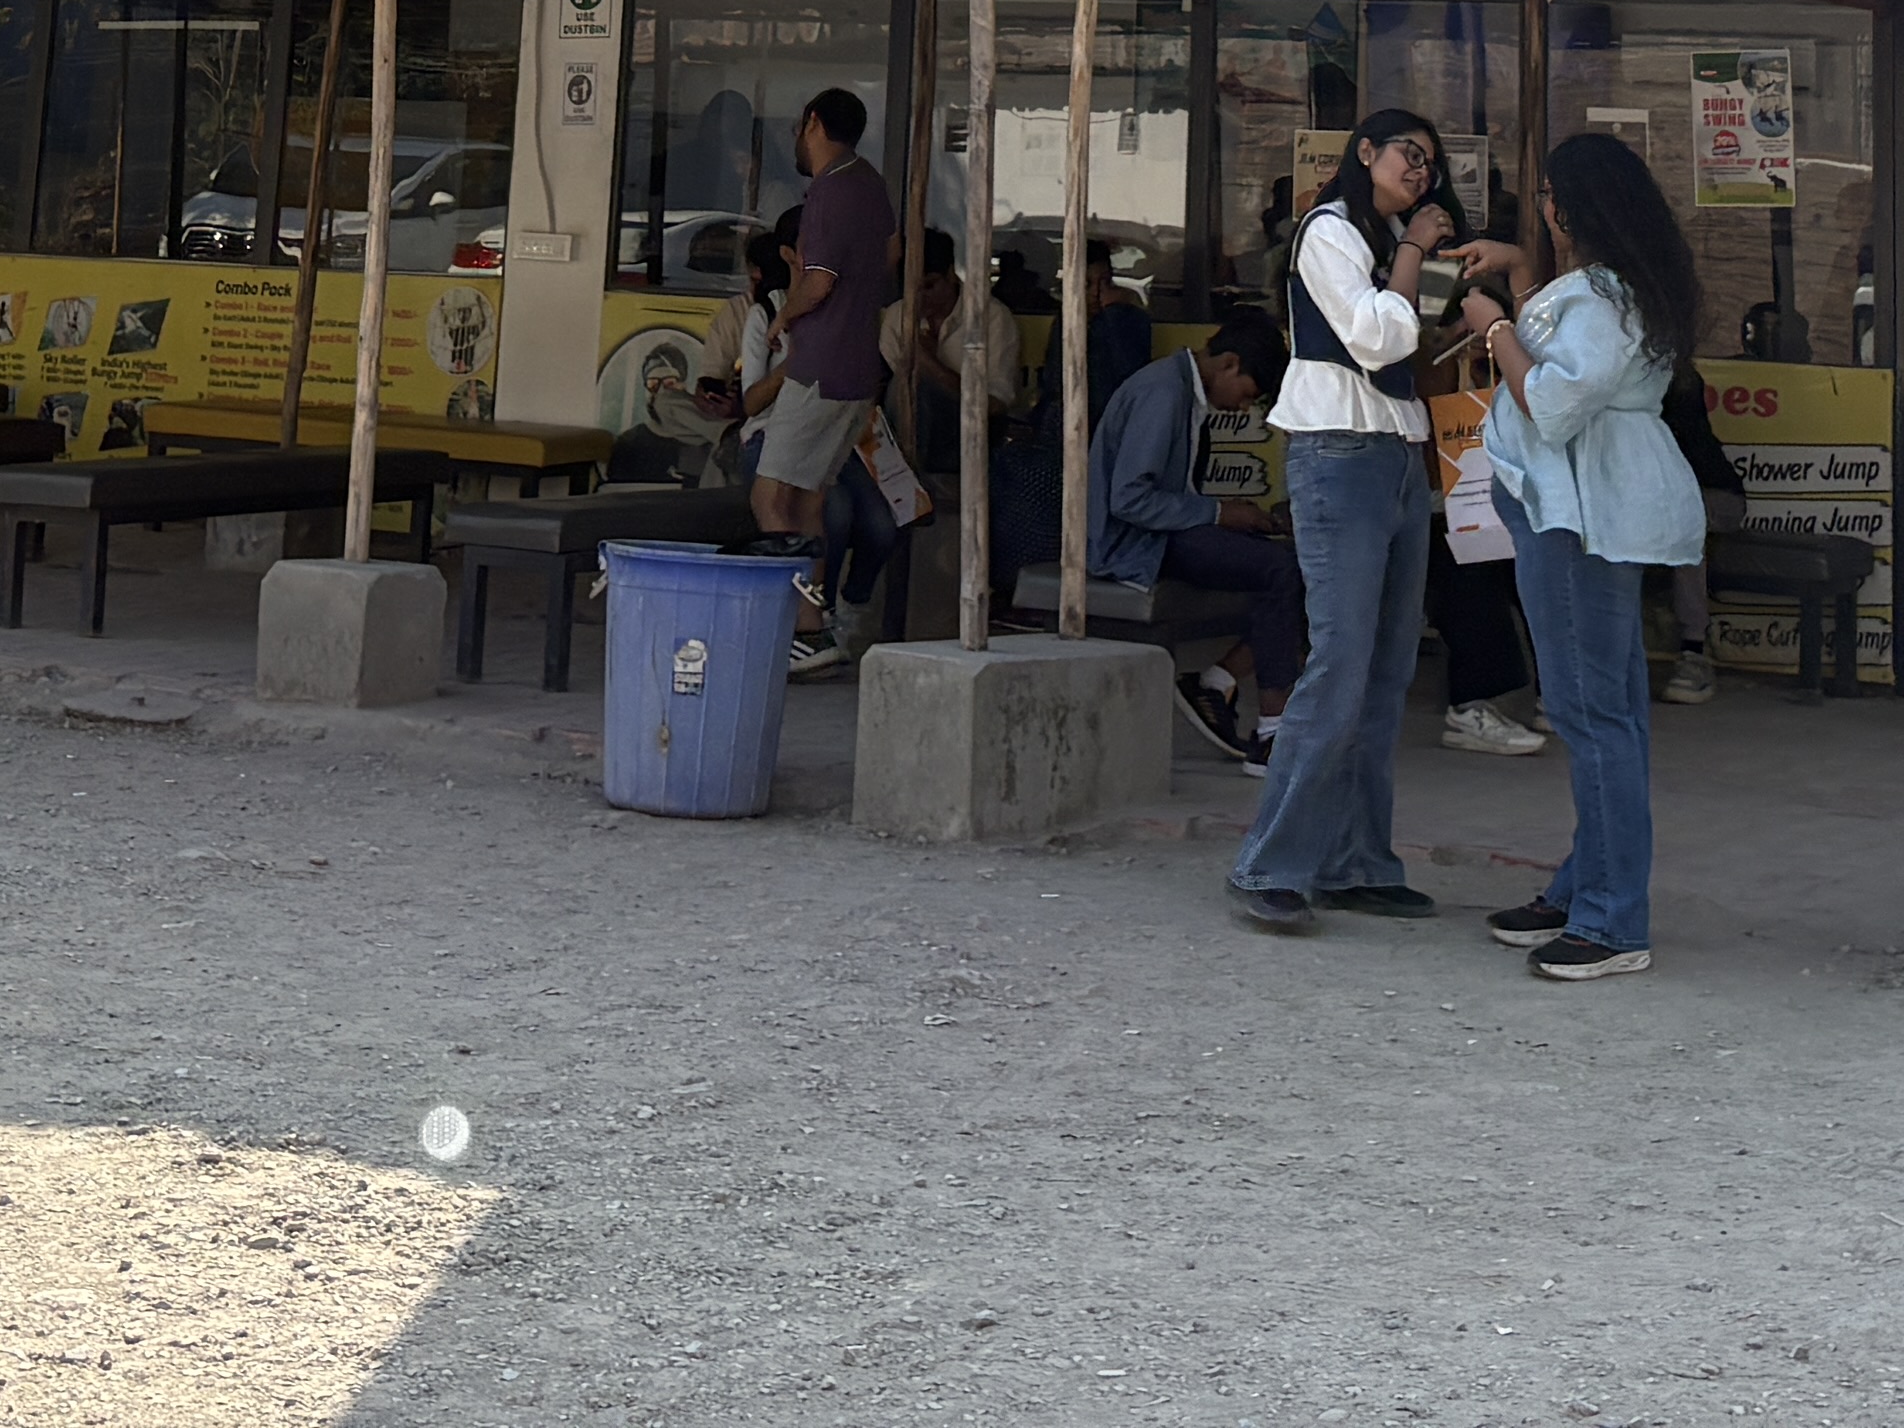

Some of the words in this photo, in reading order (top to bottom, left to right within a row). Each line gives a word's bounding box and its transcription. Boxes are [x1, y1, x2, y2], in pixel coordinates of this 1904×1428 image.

[576, 12, 595, 22] USE
[563, 24, 606, 35] DUSTBIN
[1703, 98, 1744, 111] BUNGY
[1703, 113, 1746, 127] SWING
[215, 280, 258, 296] Combo
[261, 282, 292, 297] Pack
[43, 353, 58, 366] Sky
[1207, 413, 1250, 436] ump
[1733, 453, 1814, 482] Shower
[1819, 453, 1880, 486] Jump
[1822, 507, 1883, 537] Jump
